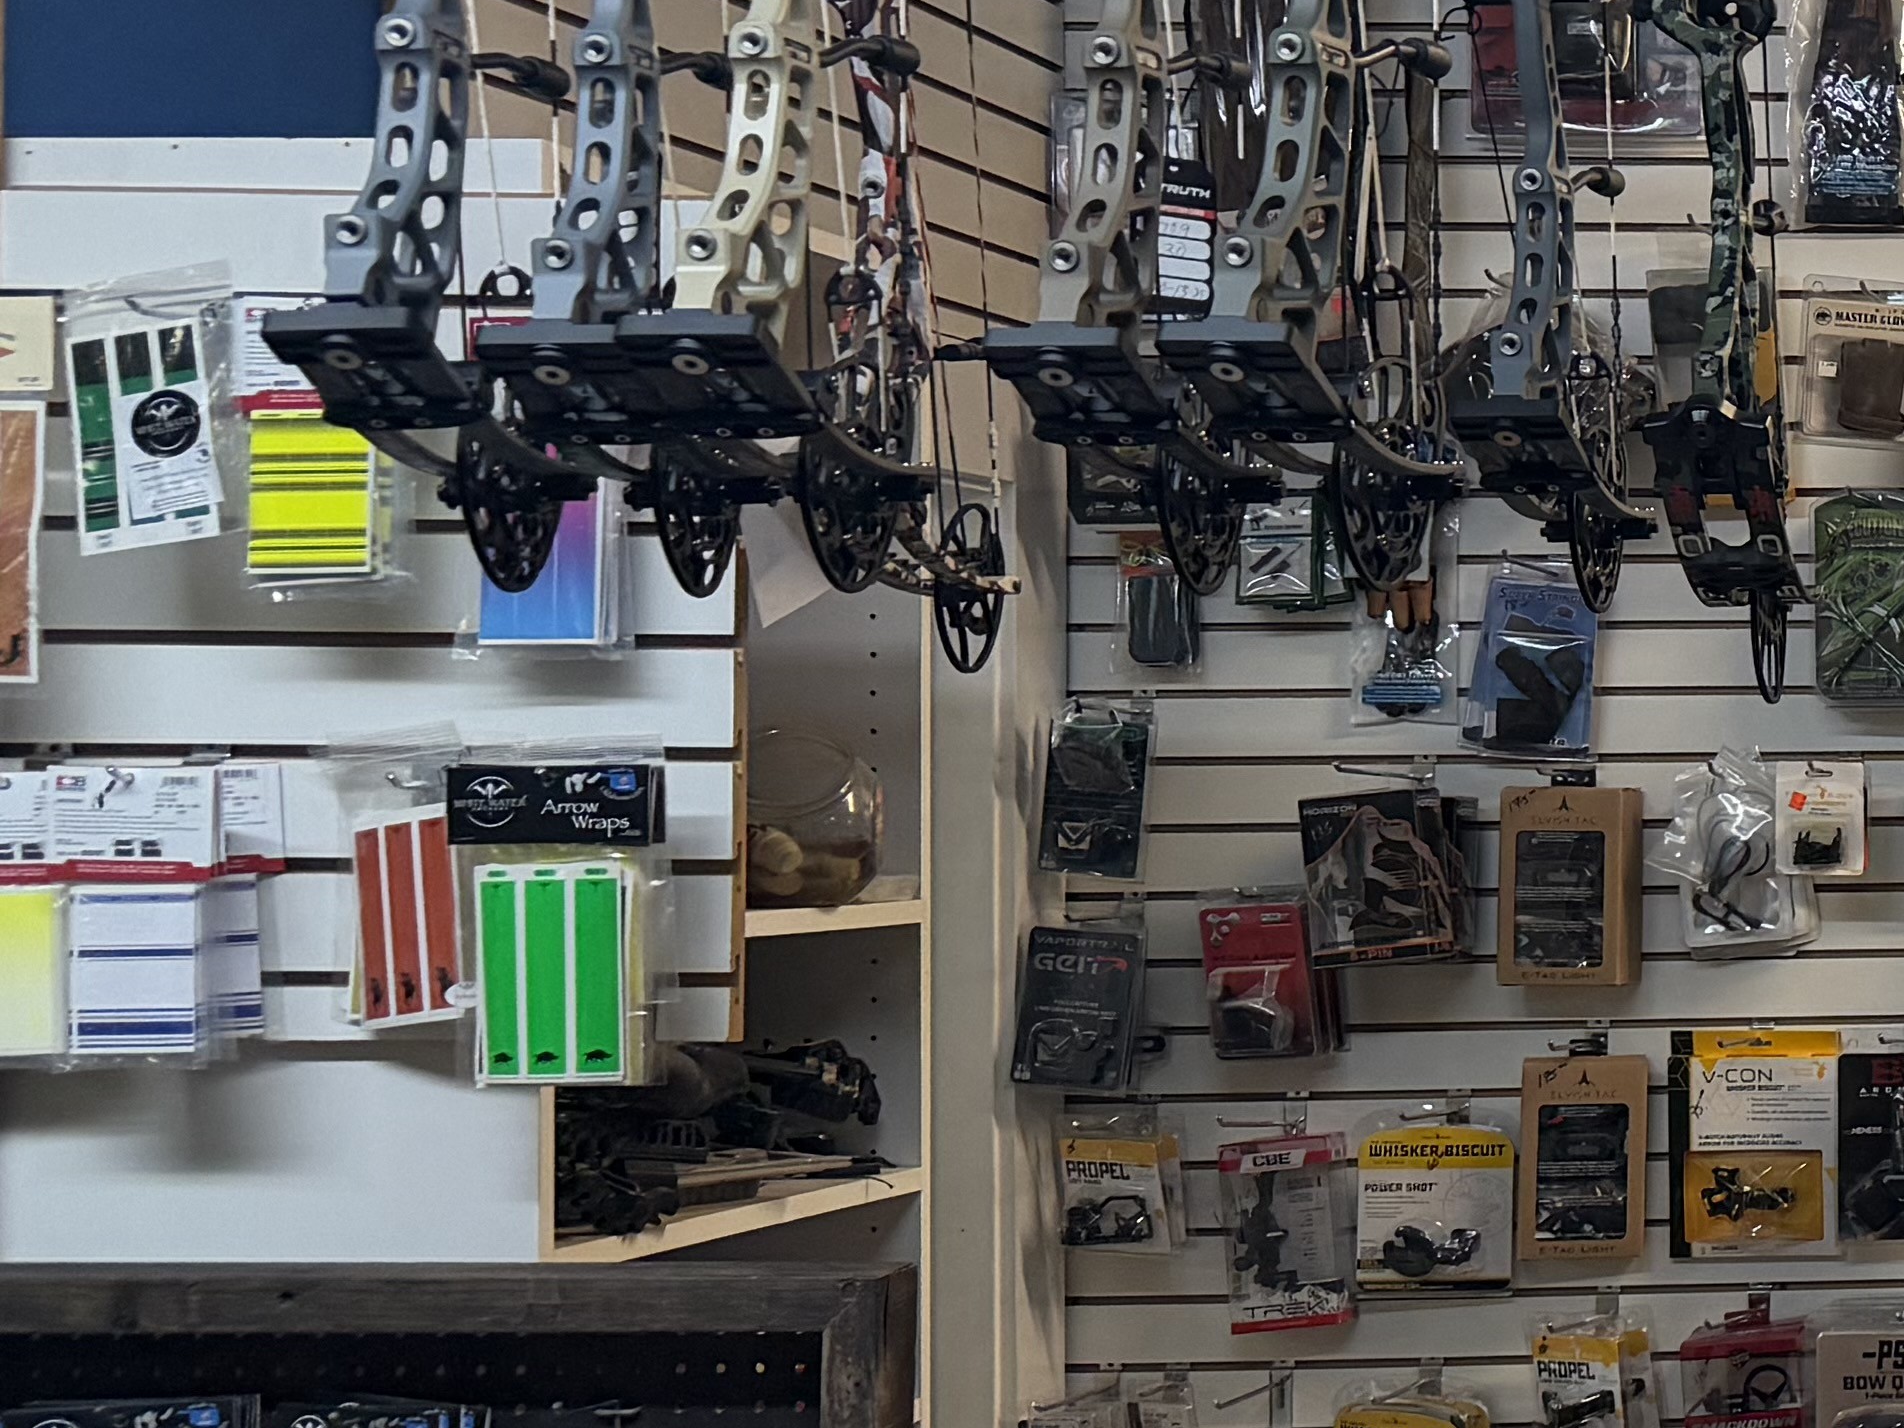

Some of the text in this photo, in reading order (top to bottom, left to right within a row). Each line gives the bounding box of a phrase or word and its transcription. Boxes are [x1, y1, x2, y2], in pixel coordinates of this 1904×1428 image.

[1835, 310, 1877, 326] MASTER
[540, 799, 600, 818] Arrow
[570, 813, 630, 838] Wraps
[1702, 1067, 1774, 1083] V-CON
[1369, 1142, 1506, 1160] WHISKER BISCUIT
[1066, 1160, 1130, 1181] PROPEL
[1537, 1360, 1597, 1380] PROPEL
[1843, 1374, 1889, 1392] BOW
